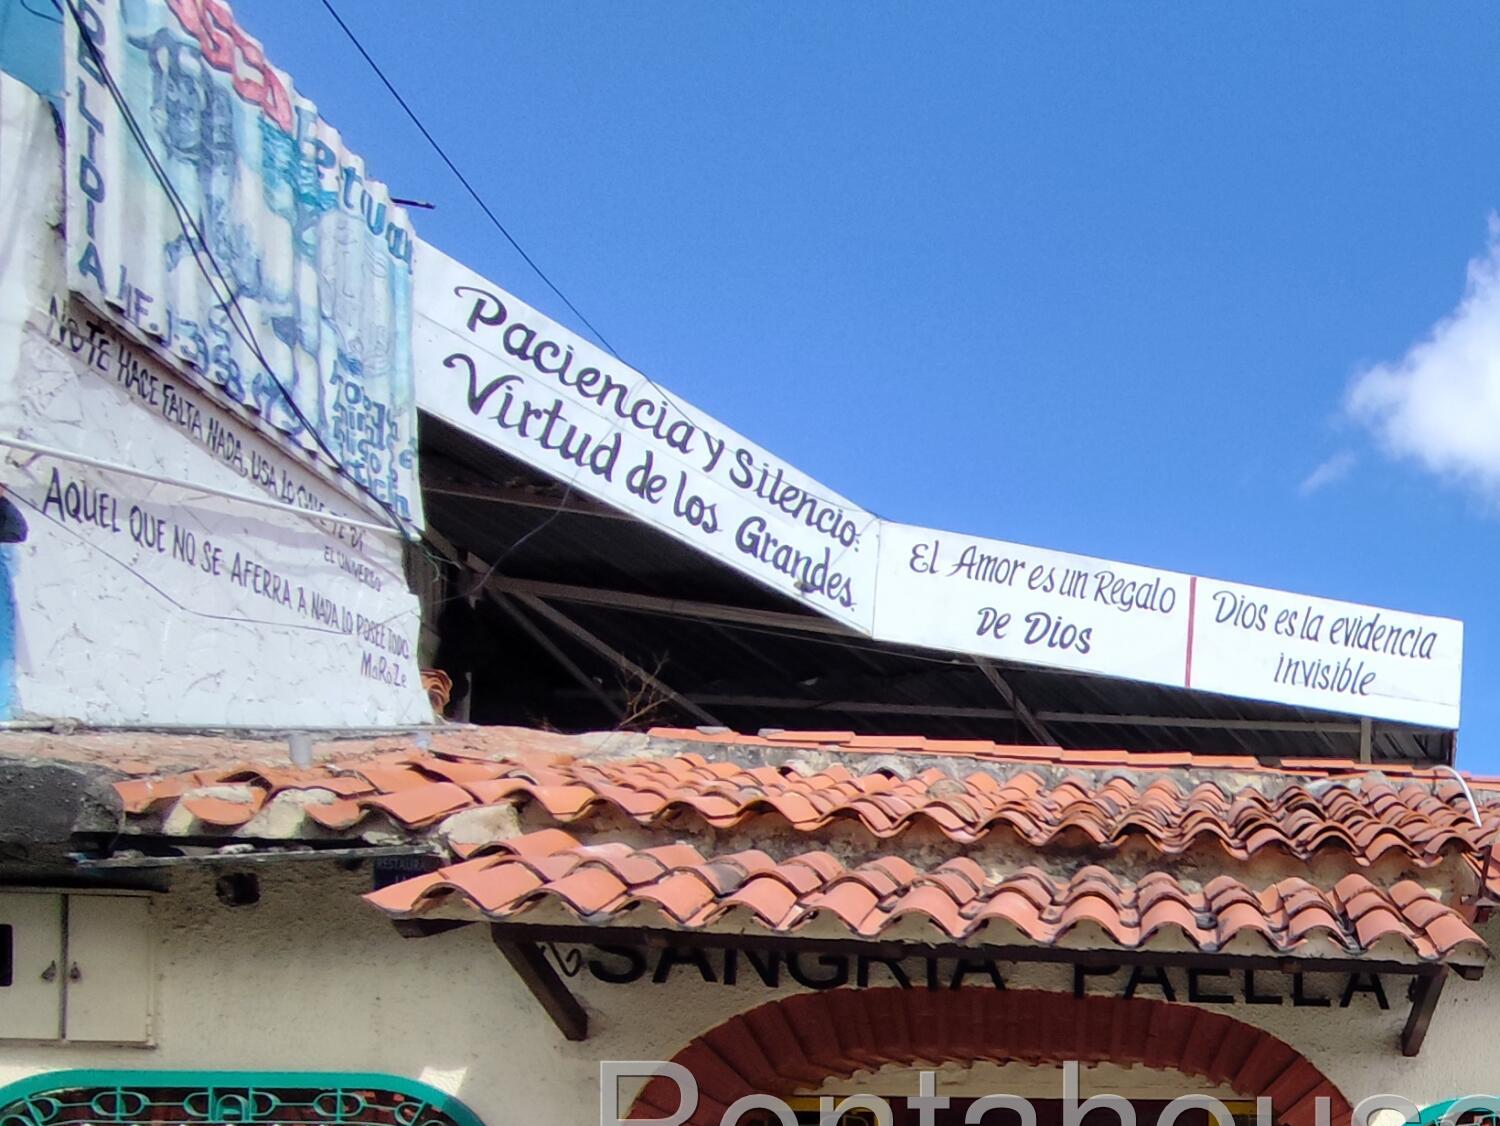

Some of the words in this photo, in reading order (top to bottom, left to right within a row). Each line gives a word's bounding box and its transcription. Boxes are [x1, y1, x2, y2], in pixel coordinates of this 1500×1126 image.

[86, 320, 111, 372] TE
[117, 344, 160, 406] HACE
[163, 383, 203, 442] FALTA
[251, 450, 277, 497] USA
[453, 286, 695, 455] Paciencia
[702, 431, 725, 472] y
[442, 353, 622, 483] Virtud
[626, 450, 667, 504] de
[673, 471, 723, 534] los
[43, 467, 121, 533] AQUEL
[129, 505, 167, 553] QUE
[173, 524, 196, 567] NO
[201, 540, 223, 576] SE
[230, 551, 293, 610] AFERRA
[311, 590, 340, 630] NADA
[909, 541, 938, 574] El
[947, 544, 1026, 587] Amor
[1027, 564, 1058, 594] es
[1058, 564, 1089, 599] un
[1093, 569, 1176, 614] Regalo
[976, 606, 1007, 640] De
[1023, 607, 1094, 655] Dios
[1212, 590, 1266, 632] Dios
[1275, 606, 1297, 637] es
[1300, 604, 1321, 641] la
[1330, 609, 1439, 660] evidencia
[1273, 651, 1377, 696] invisible
[1072, 958, 1391, 1011] PAELLA
